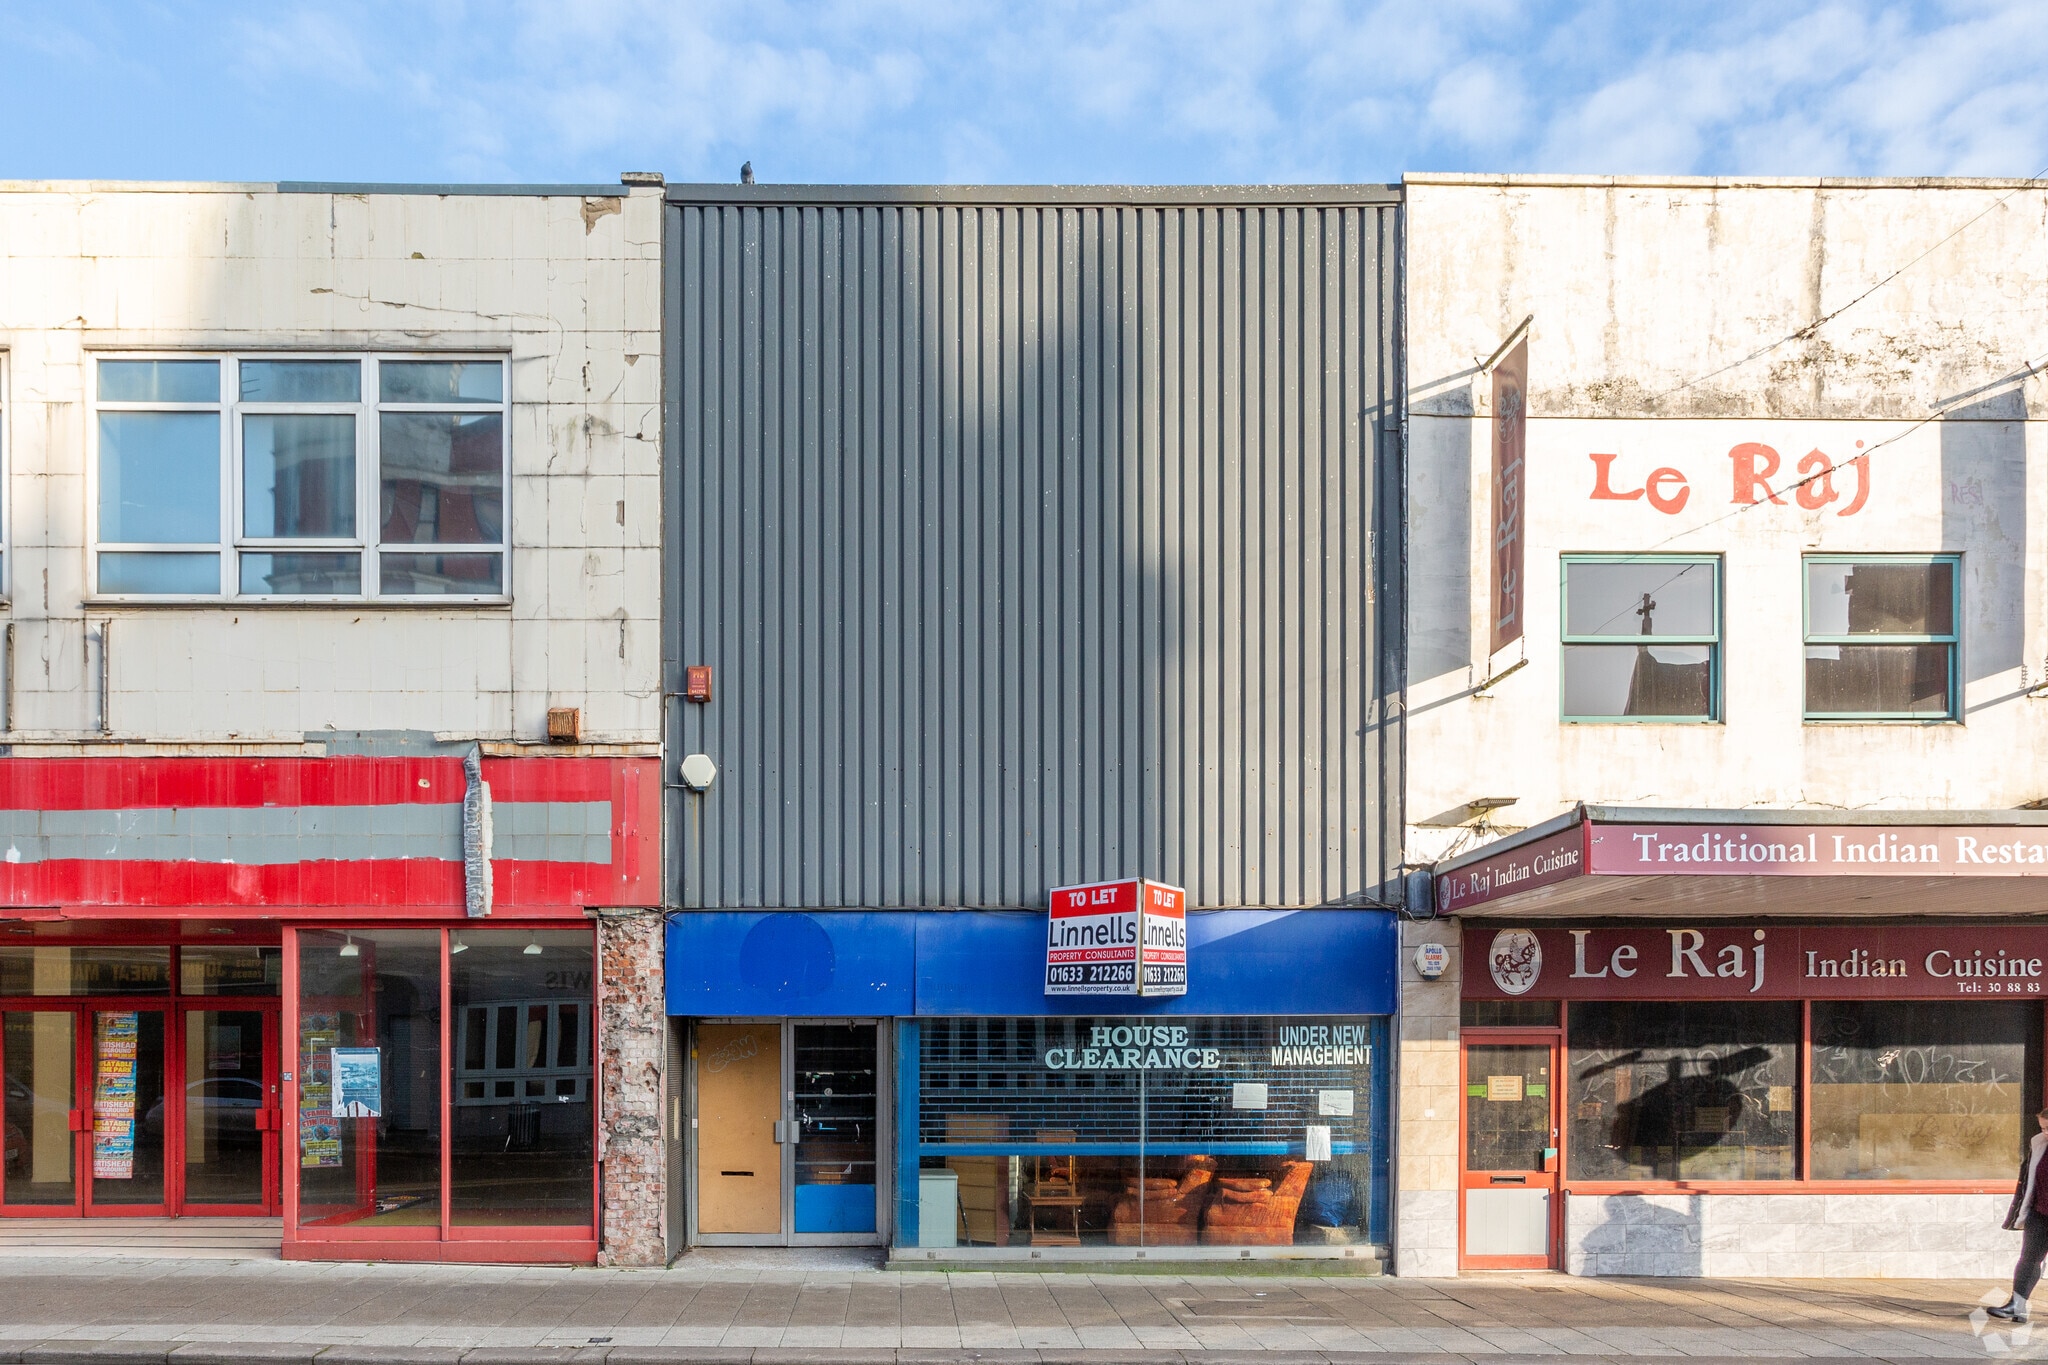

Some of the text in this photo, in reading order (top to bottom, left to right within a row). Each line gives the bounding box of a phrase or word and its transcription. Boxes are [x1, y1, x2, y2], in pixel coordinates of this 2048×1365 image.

[1589, 440, 1870, 516] Le Raj
[1495, 457, 1523, 633] Le Raj
[1632, 832, 1817, 863] Traditional
[1831, 833, 1940, 864] Indian
[1452, 847, 1579, 900] Le Raj Indian Cuisine
[1069, 887, 1117, 907] TO LET
[1153, 889, 1175, 908] TO LET
[1049, 916, 1136, 947] Linnells
[1144, 917, 1185, 947] Linnells
[1050, 949, 1135, 961] PROPERTY CONSULTANTS
[1569, 929, 2043, 993] Le Raj Indian Cuisine
[1050, 965, 1133, 982] 01633 212266
[1143, 967, 1184, 982] 01633 212266
[1051, 984, 1131, 992] www.linnellsproperty.co.uk
[1957, 982, 2041, 993] Tel: 30 88 83
[1090, 1026, 1189, 1047] HOUSE
[1279, 1025, 1366, 1046] UNDER NEW
[1045, 1048, 1220, 1069] CLEARANCE
[1272, 1045, 1372, 1066] MANAGEMENT
[301, 1117, 339, 1127] FUN PARK
